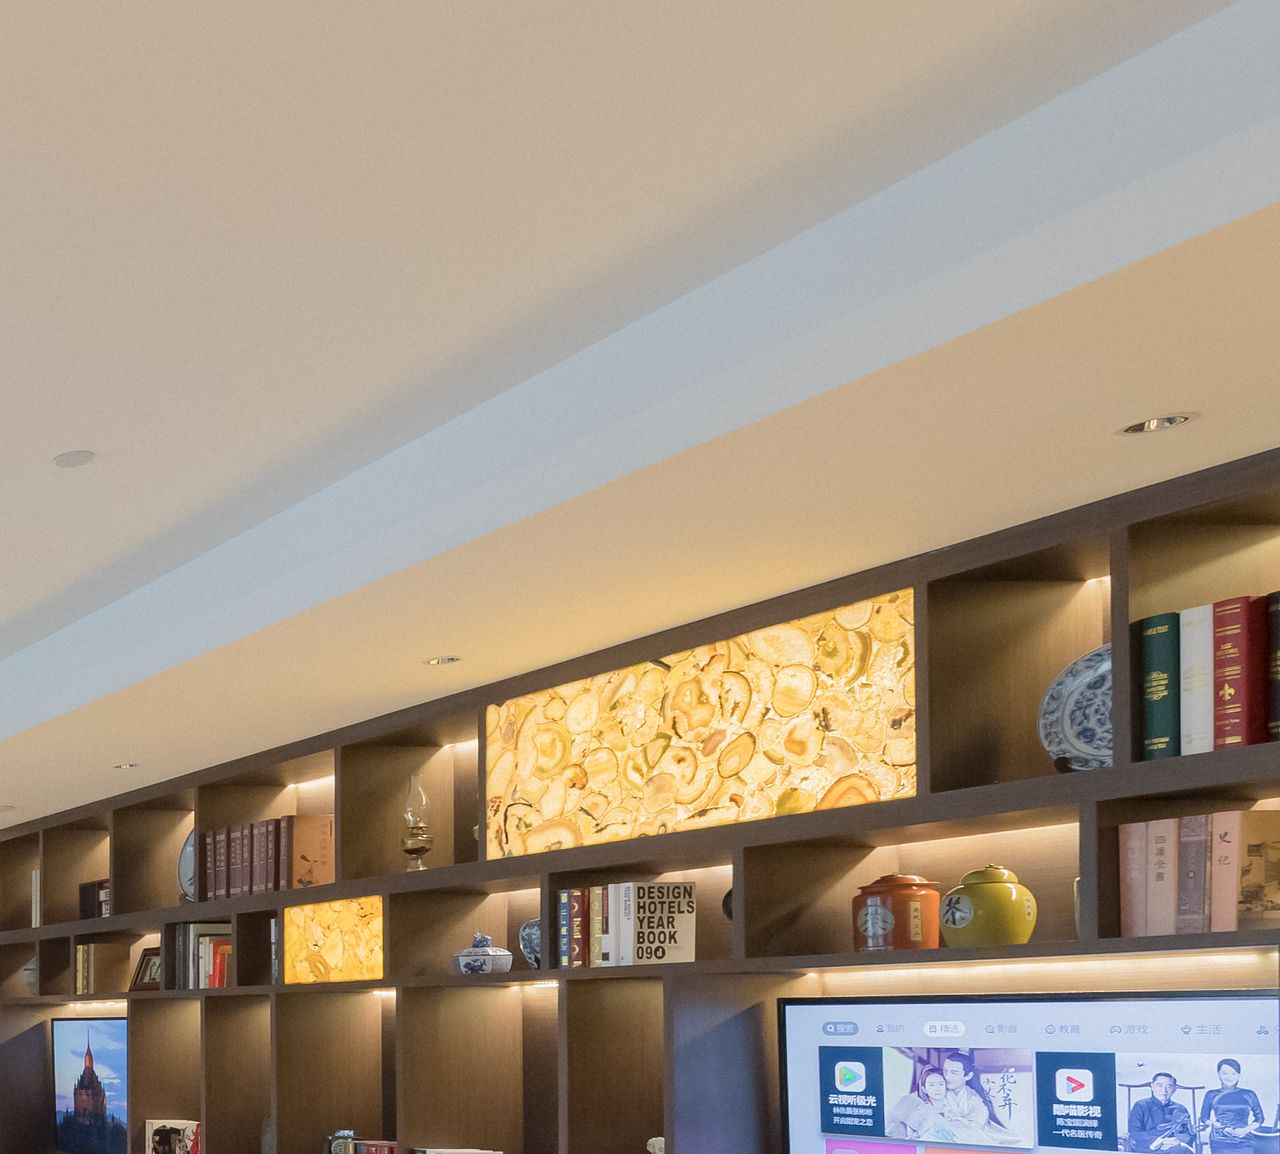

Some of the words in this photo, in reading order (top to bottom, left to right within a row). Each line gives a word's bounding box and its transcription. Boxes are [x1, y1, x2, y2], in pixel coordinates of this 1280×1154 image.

[1217, 831, 1232, 866] 史记
[636, 885, 693, 900] DESIGN
[636, 900, 695, 915] HOTELS
[636, 915, 676, 930] YEAR
[636, 931, 678, 945] BOOK
[636, 945, 653, 960] 09
[887, 1024, 905, 1034] 我的
[940, 1024, 960, 1034] 精选
[1059, 1024, 1080, 1035] 教育
[1124, 1024, 1149, 1035] 游戏
[1196, 1024, 1222, 1035] 生活
[828, 1094, 877, 1107] 云视听极光
[1052, 1103, 1102, 1118] 酷喵影视
